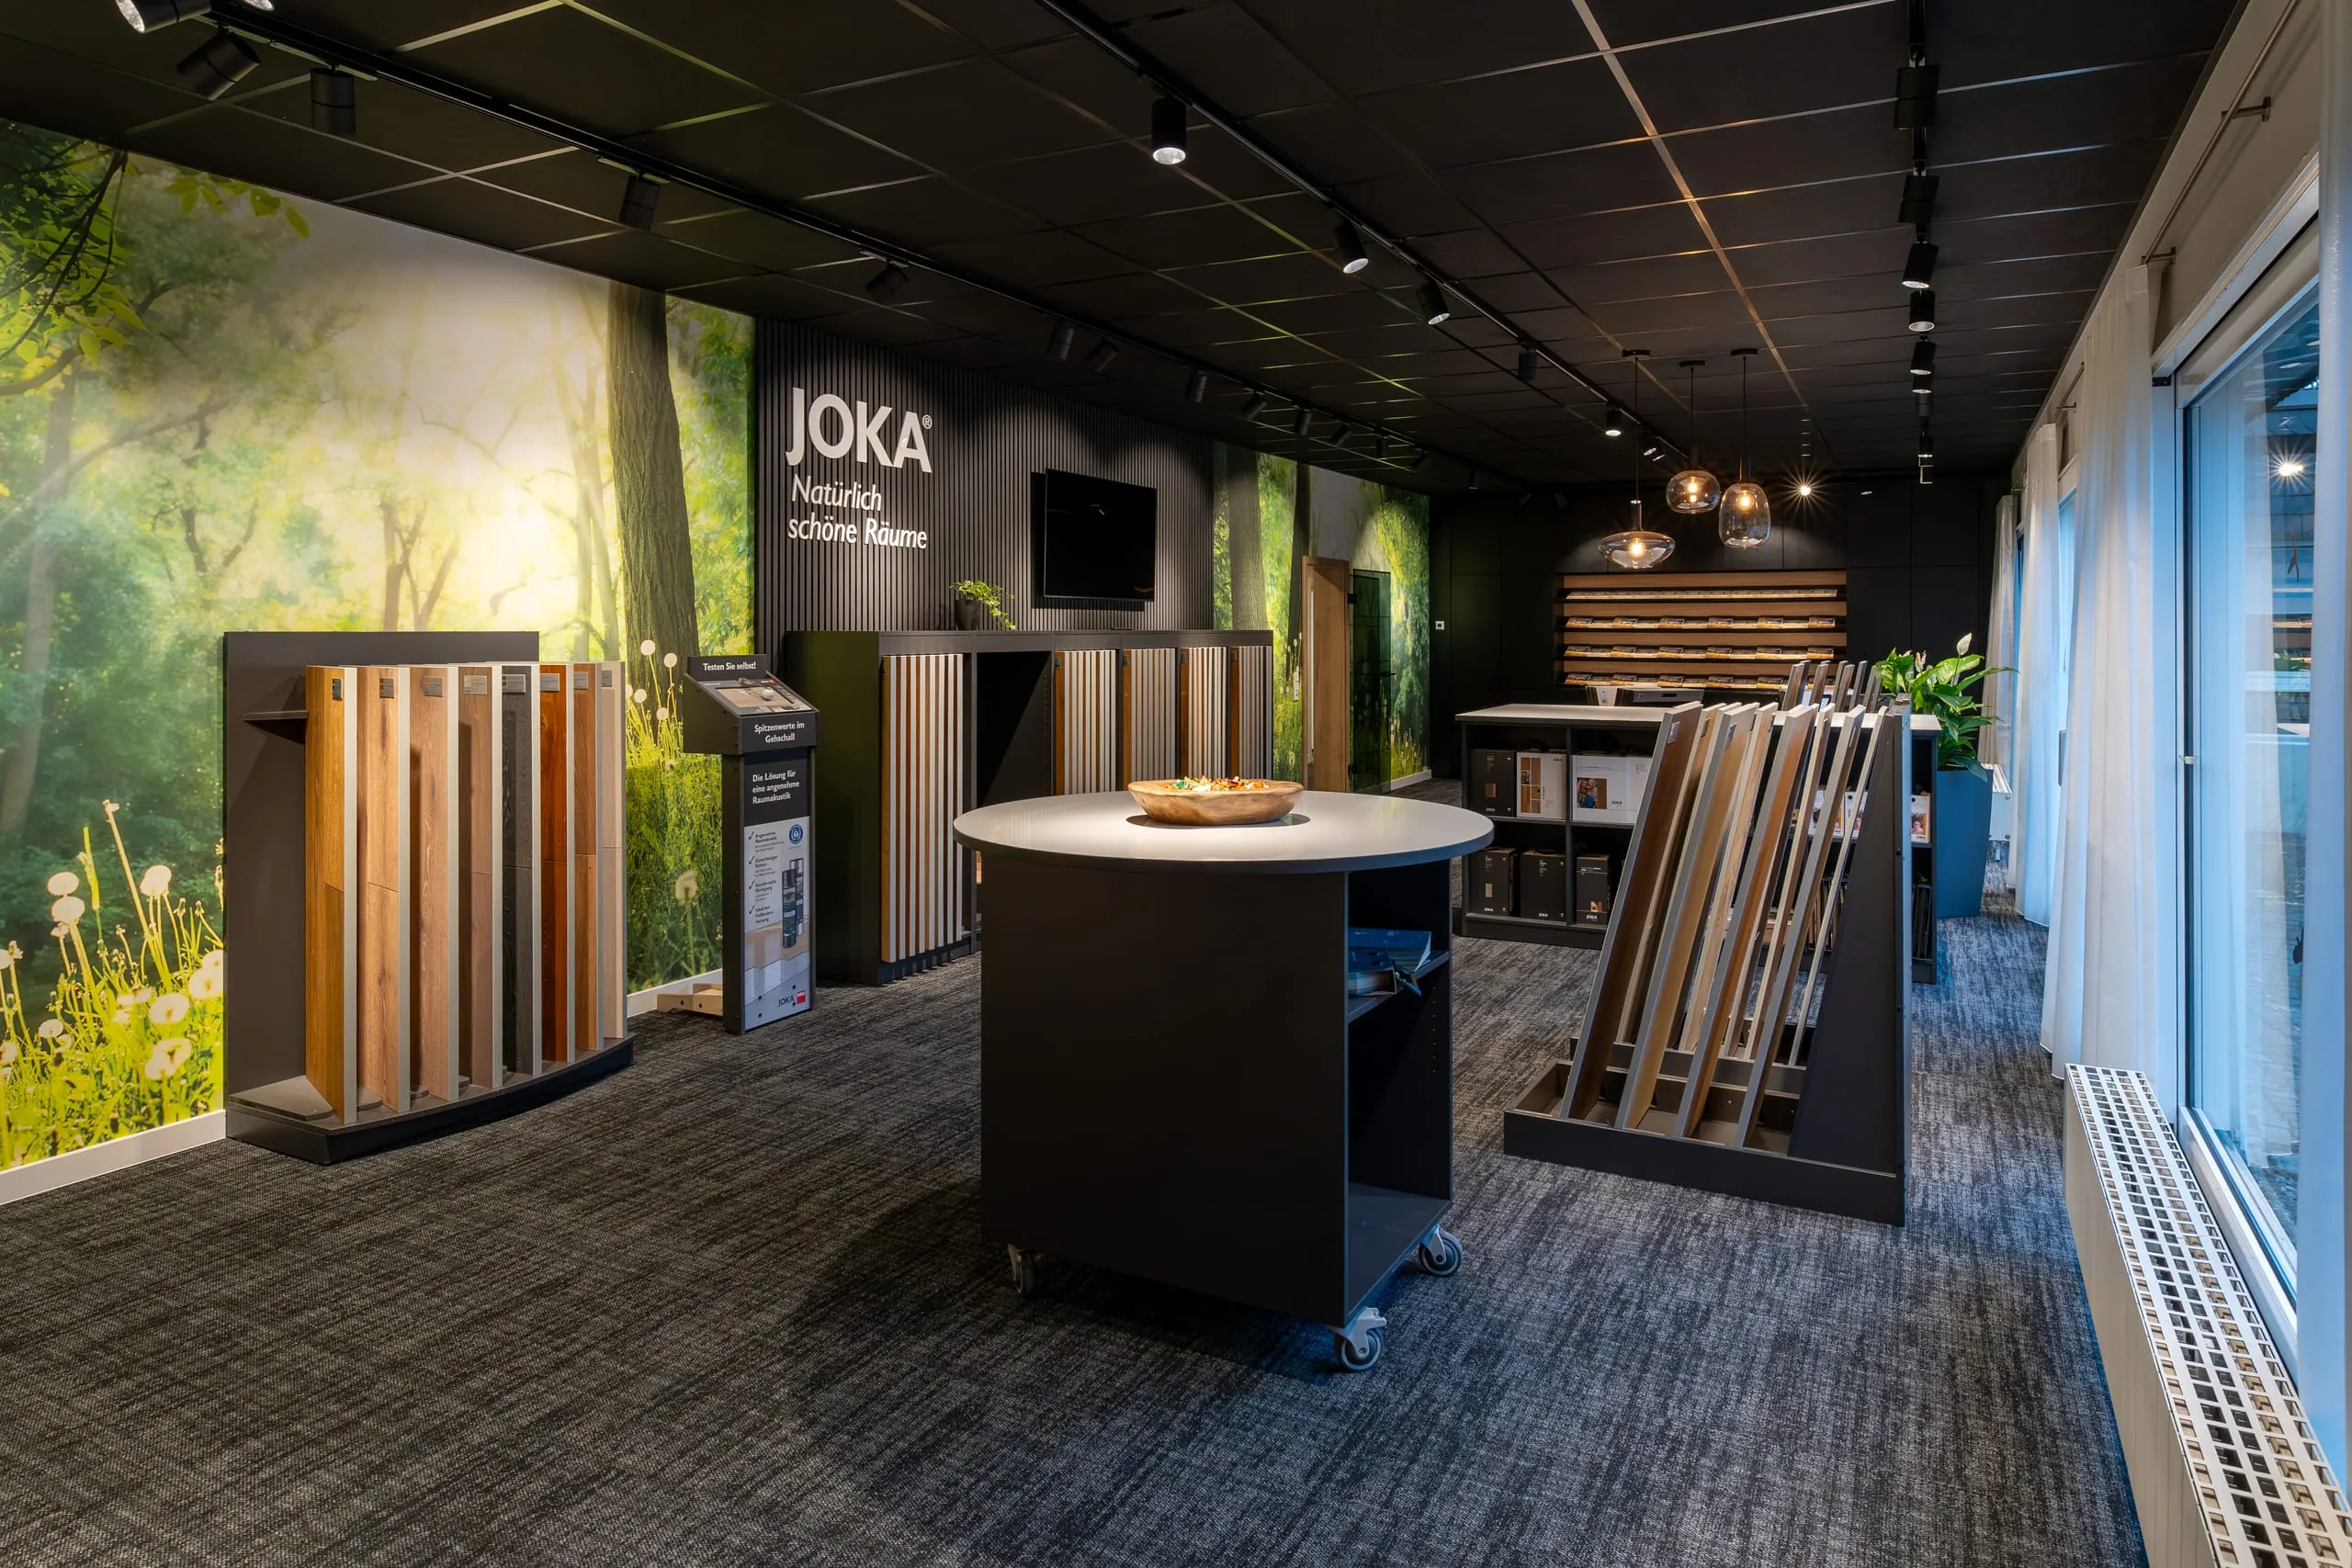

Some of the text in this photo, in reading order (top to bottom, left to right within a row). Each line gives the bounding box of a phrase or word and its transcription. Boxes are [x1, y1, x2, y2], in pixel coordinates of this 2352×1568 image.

[791, 474, 882, 512] Natürlich
[787, 512, 928, 549] schöne Räume
[703, 660, 756, 671] Testen Sie selbst!
[754, 720, 805, 734] Spitzenwerte im
[764, 732, 796, 743] Gehschall
[752, 770, 797, 783] Die Lösung für
[752, 781, 800, 794] eine angenehme
[752, 792, 791, 805] Raumakustik
[778, 995, 795, 1007] JOKA
